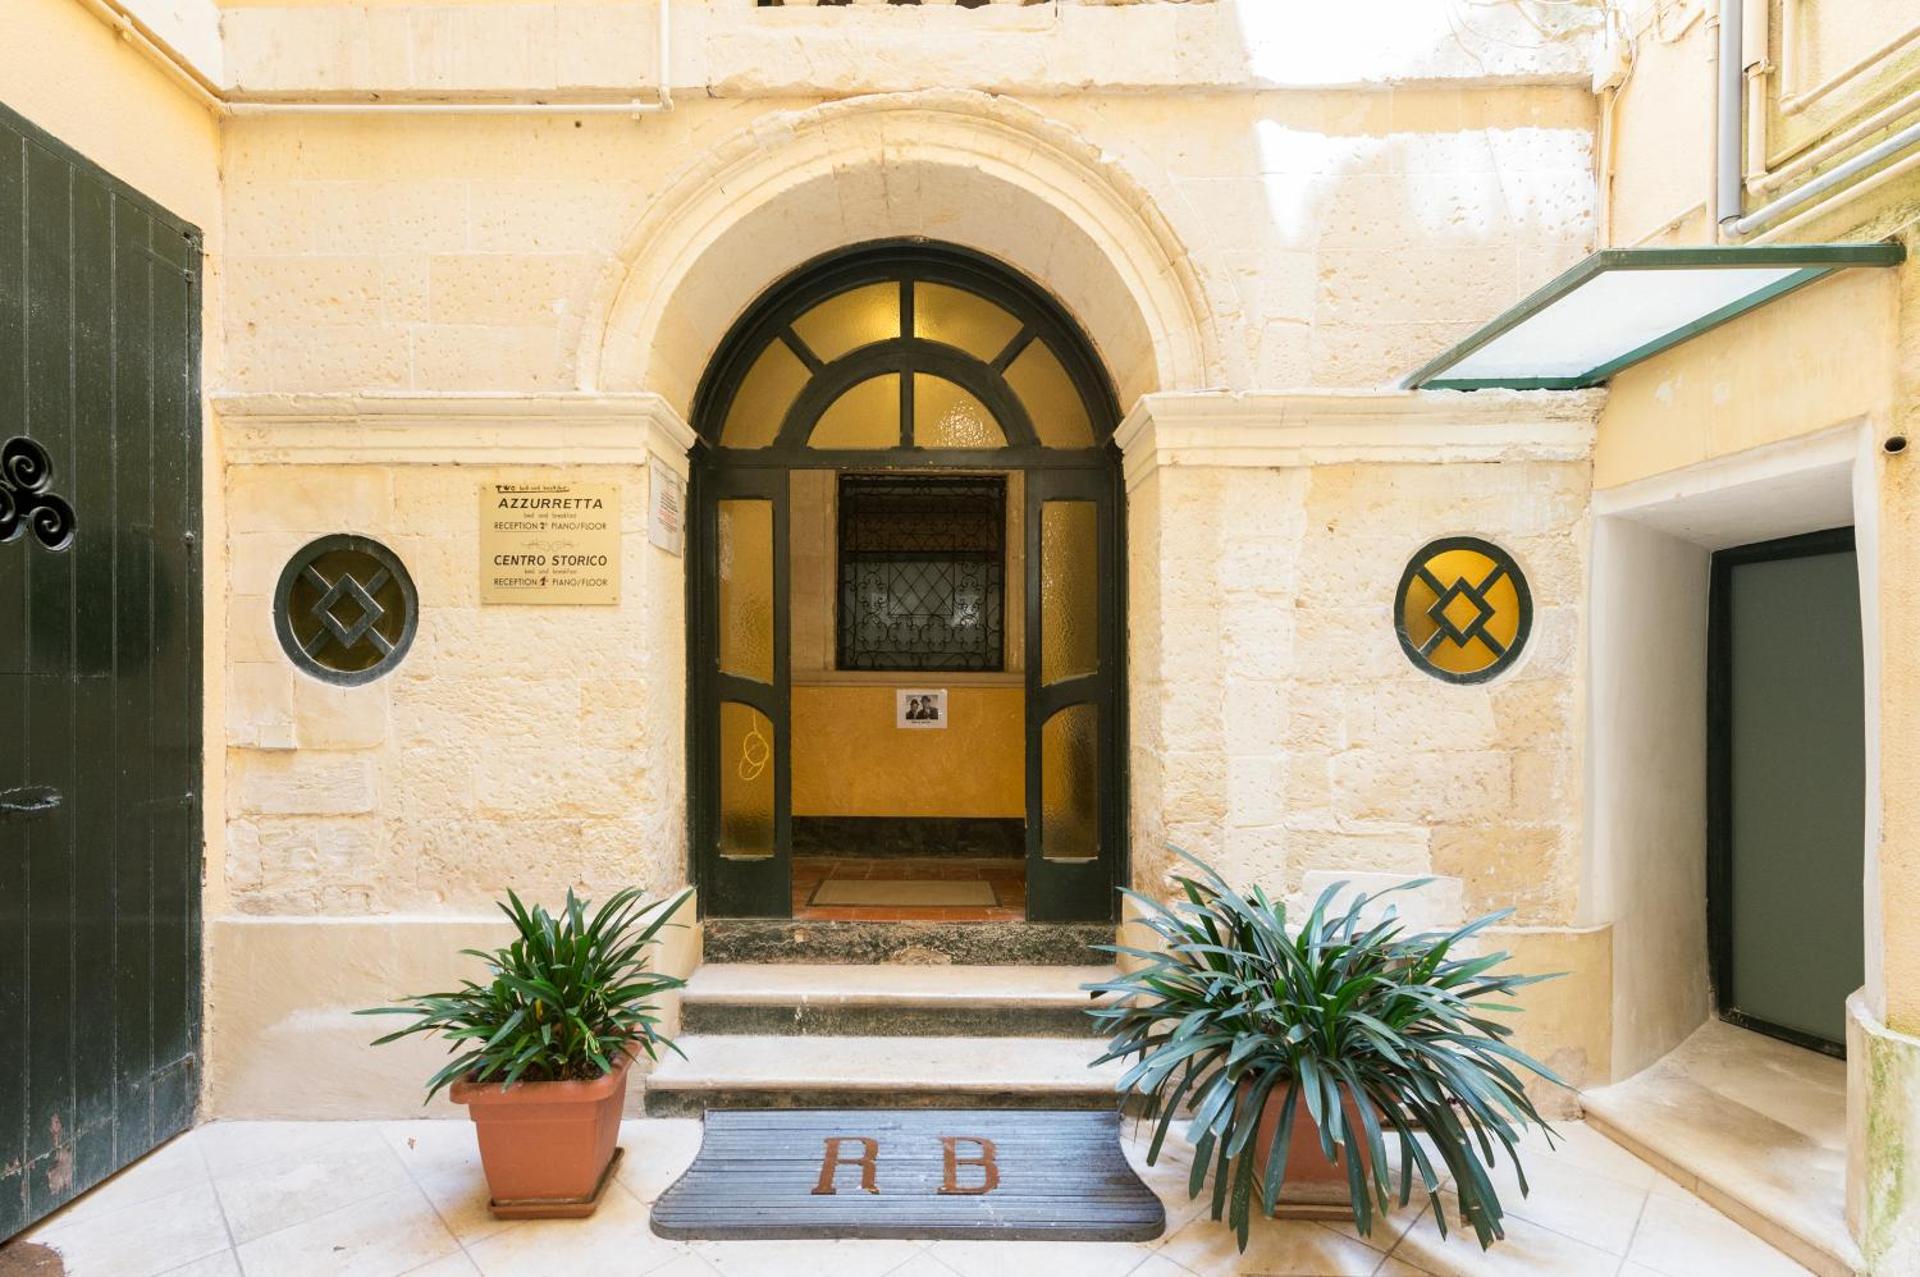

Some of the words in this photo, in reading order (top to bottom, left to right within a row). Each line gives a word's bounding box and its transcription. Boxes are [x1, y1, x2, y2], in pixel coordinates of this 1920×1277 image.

[498, 498, 603, 509] AZZURRETTA
[494, 522, 538, 531] RECEPTION
[551, 522, 607, 531] PIANO/FLOOR
[494, 555, 546, 566] CENTRO
[552, 555, 608, 566] STORICO
[494, 577, 537, 587] RECEPTION
[552, 577, 608, 587] PIANO/FLOOR
[811, 1137, 879, 1196] R
[937, 1137, 1000, 1196] B
